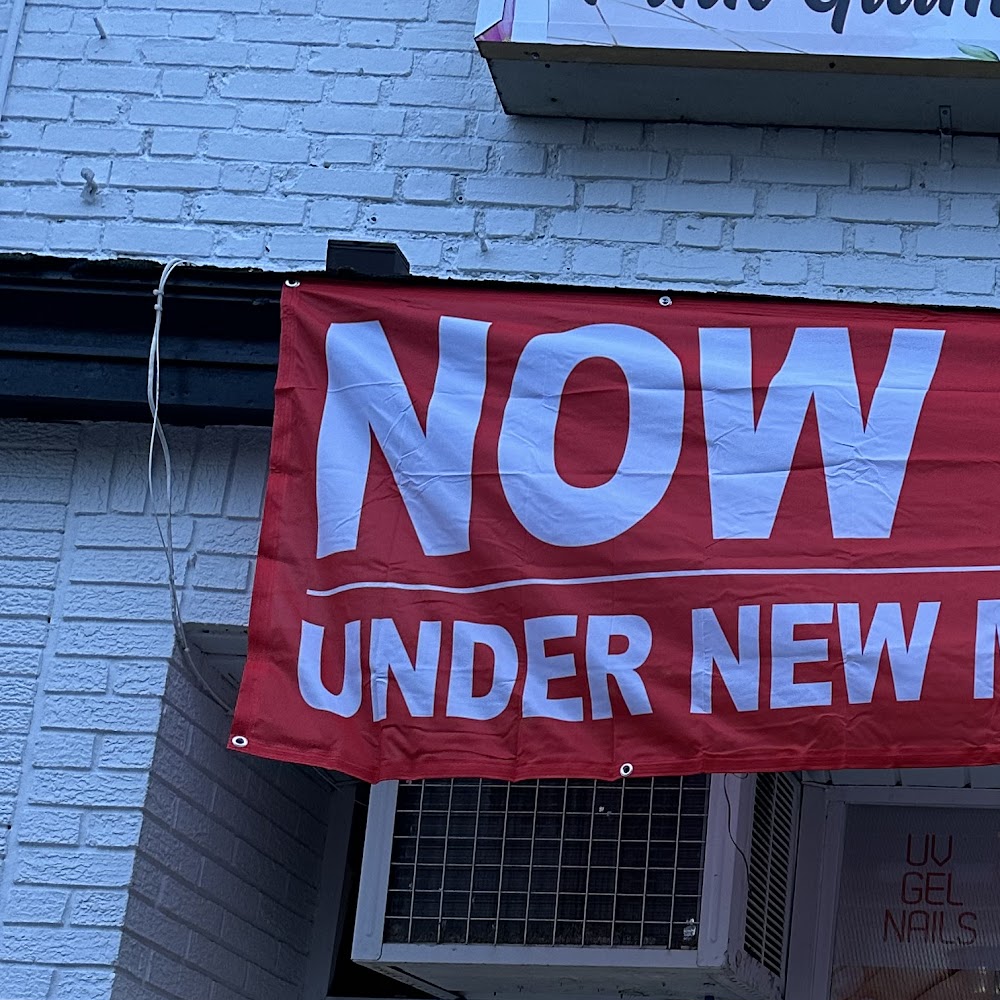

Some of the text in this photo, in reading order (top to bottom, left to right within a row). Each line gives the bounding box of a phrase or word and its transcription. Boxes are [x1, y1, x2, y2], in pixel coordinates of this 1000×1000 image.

[316, 316, 946, 559] NOW
[297, 614, 653, 722] UNDER
[690, 602, 941, 714] NEW
[906, 833, 953, 867] UV
[901, 871, 964, 907] GEL
[883, 910, 978, 946] NAILS
